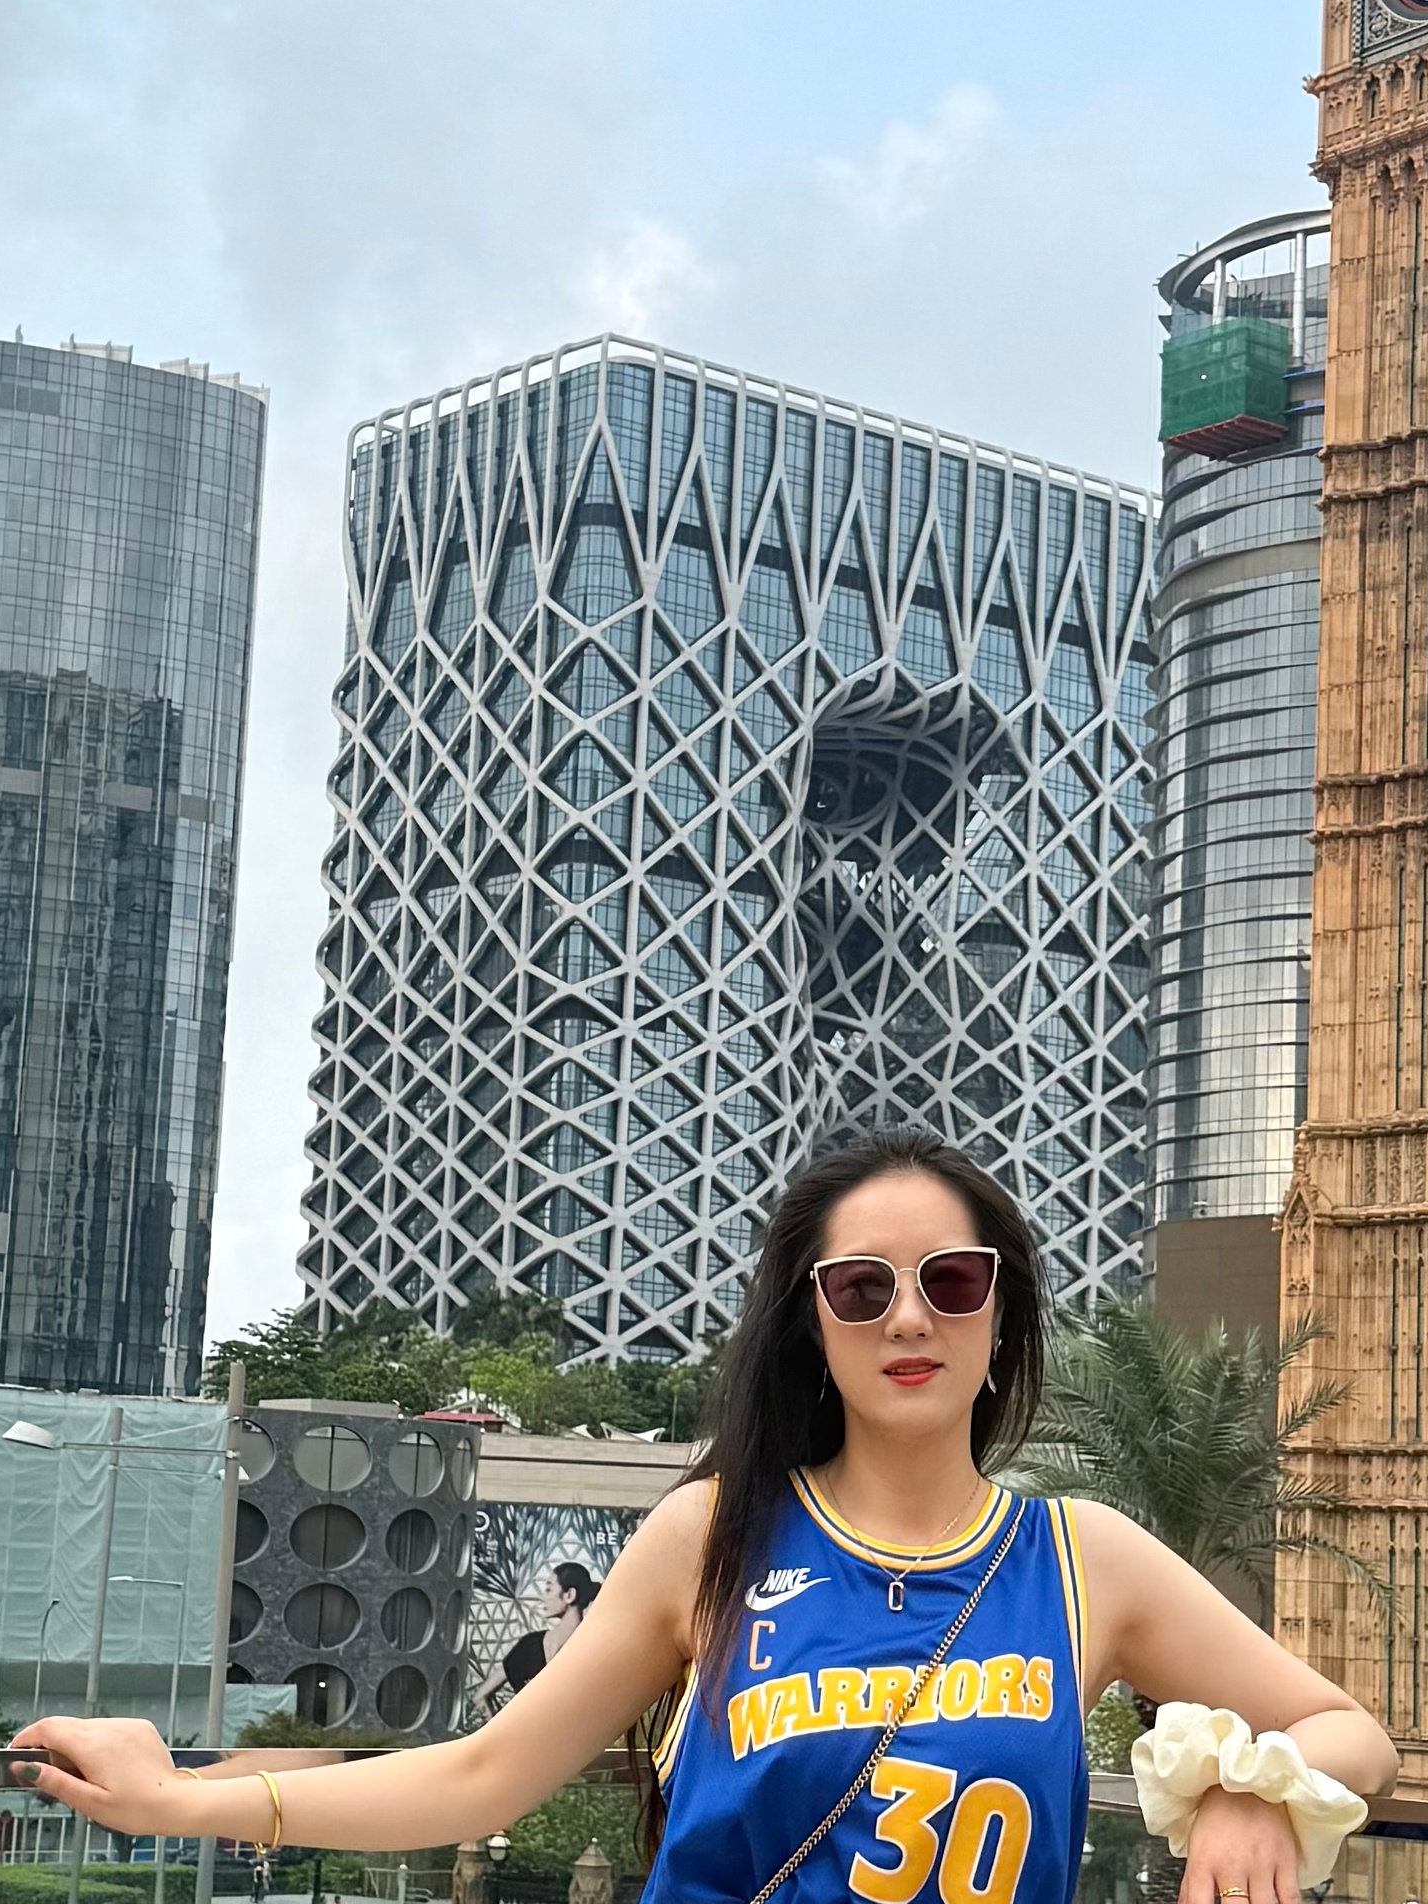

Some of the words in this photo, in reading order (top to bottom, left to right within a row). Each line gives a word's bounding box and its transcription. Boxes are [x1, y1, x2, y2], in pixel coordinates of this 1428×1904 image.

[596, 1532, 618, 1545] BE
[760, 1567, 811, 1592] NIKE
[749, 1619, 776, 1671] C
[728, 1653, 1054, 1762] WARRIORS
